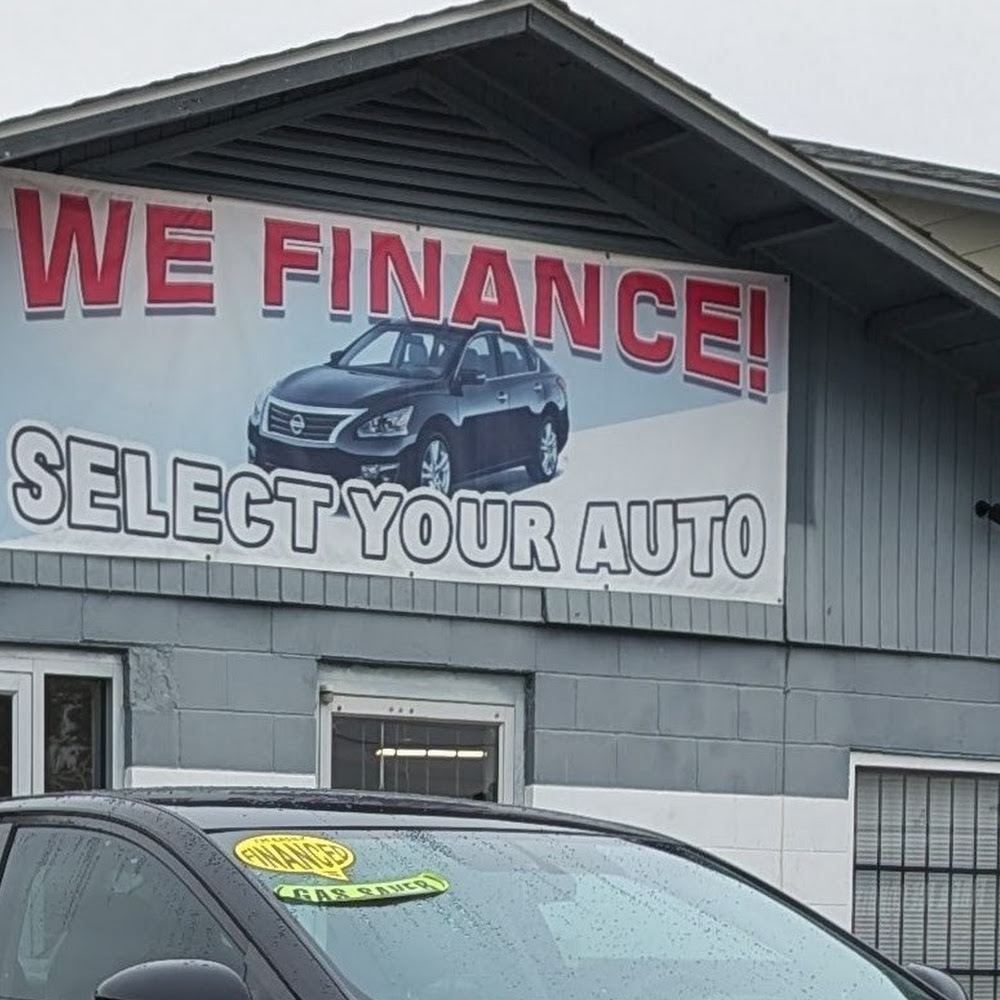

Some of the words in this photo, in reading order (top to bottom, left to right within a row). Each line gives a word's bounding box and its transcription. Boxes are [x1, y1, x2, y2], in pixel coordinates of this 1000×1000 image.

[13, 186, 216, 318] WE
[262, 216, 768, 398] FINANCE!
[10, 424, 335, 554] SELECT
[347, 486, 561, 572] YOUR
[576, 492, 767, 579] AUTO
[241, 842, 349, 870] FINANCED
[293, 887, 350, 902] GAS
